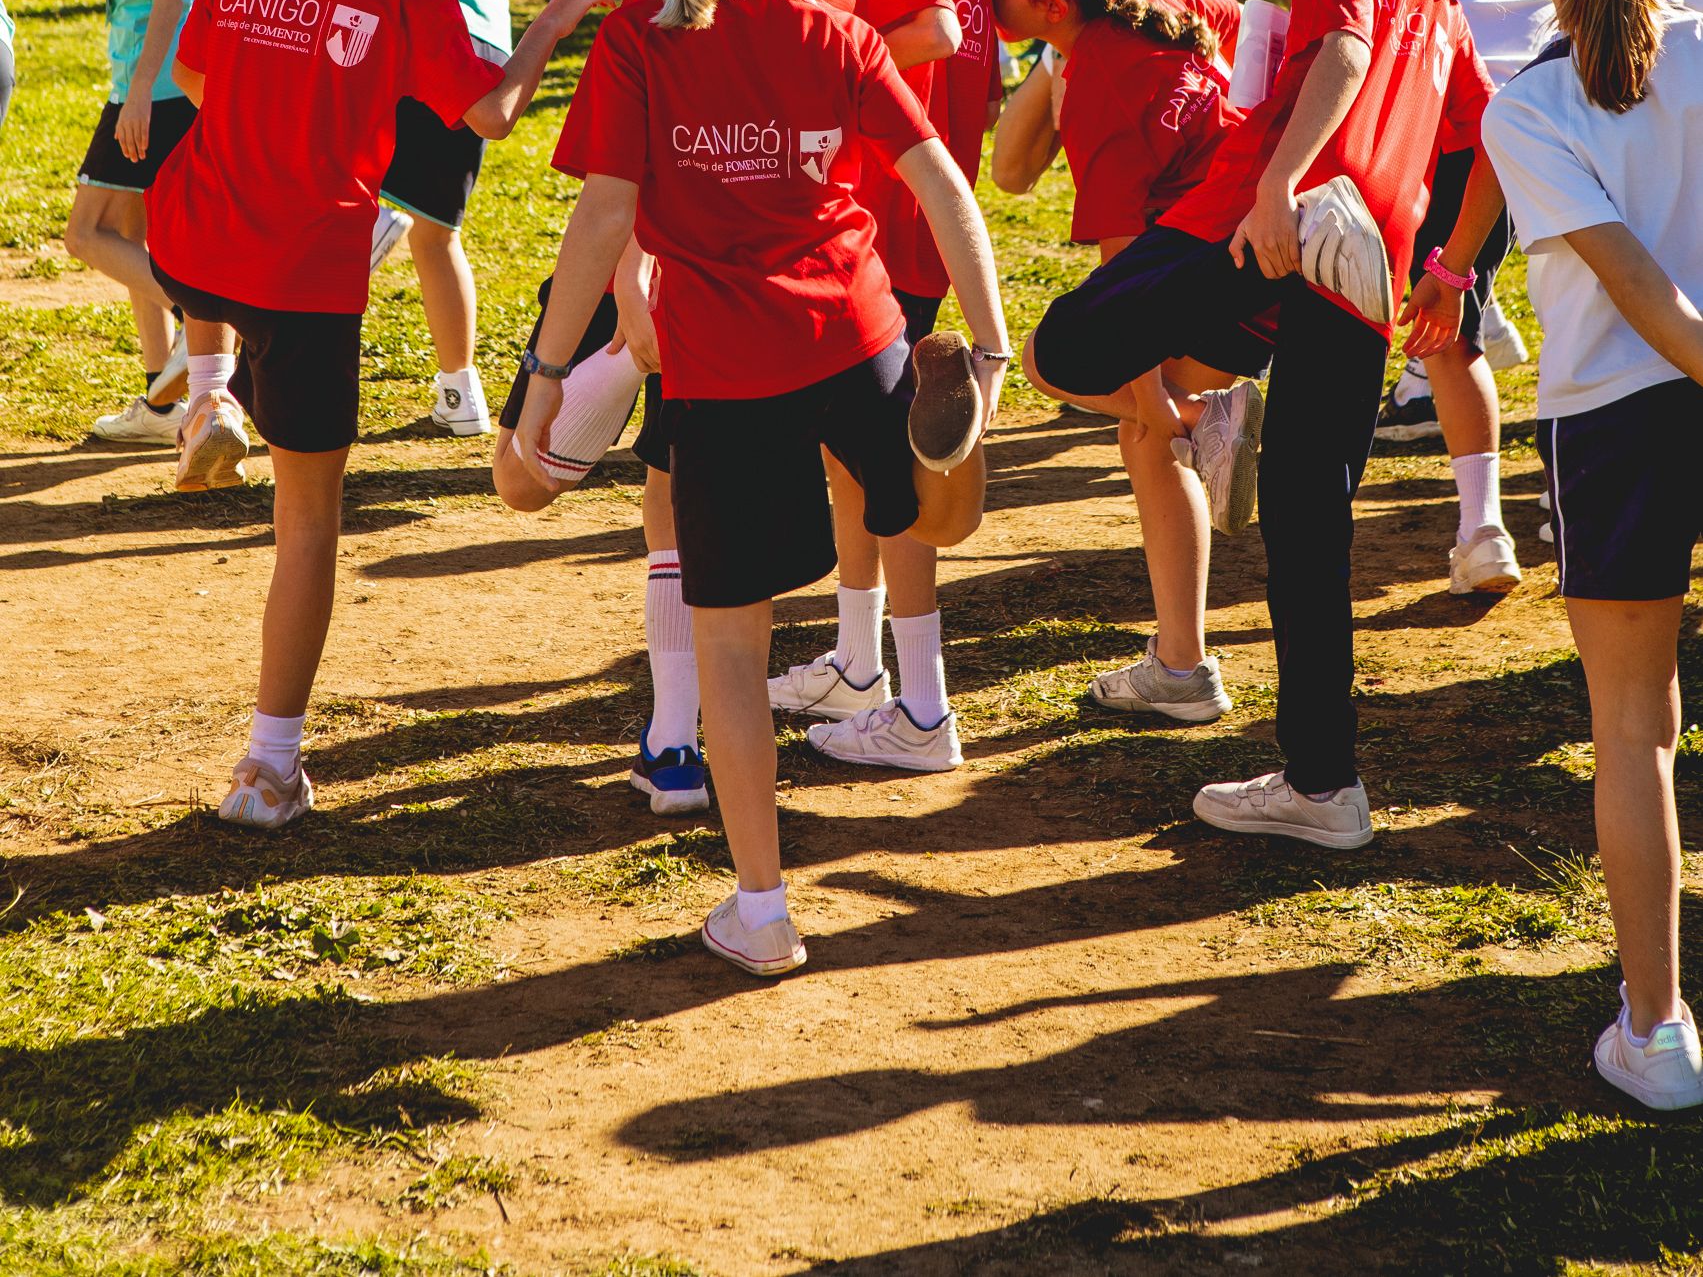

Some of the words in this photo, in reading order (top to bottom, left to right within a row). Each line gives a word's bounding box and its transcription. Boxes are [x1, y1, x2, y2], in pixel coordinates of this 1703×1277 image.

[239, 20, 250, 30] de
[251, 22, 311, 43] FOMENTO
[672, 119, 781, 156] CANIGÓ
[711, 161, 724, 172] de
[725, 158, 778, 173] FOMENTO
